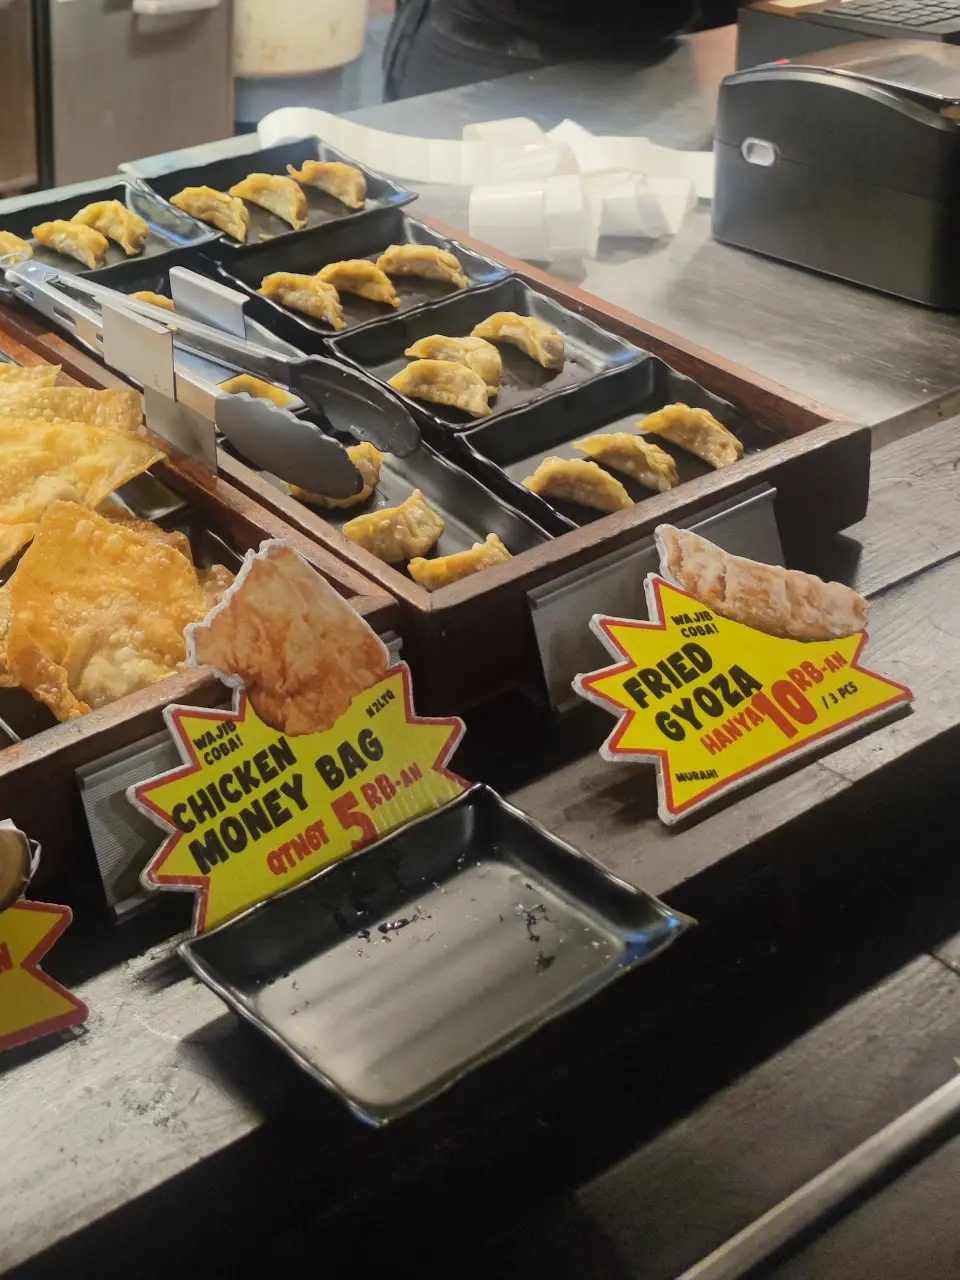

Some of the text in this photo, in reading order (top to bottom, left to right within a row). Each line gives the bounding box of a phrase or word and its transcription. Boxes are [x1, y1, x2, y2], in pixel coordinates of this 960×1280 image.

[671, 611, 713, 625] WAJIB
[681, 623, 719, 638] COBA!
[622, 642, 713, 709] FRIED
[828, 692, 838, 704] 3
[837, 681, 858, 698] PCS
[655, 664, 763, 741] GYOZA
[700, 651, 848, 755] HANYA 10 RB-AN
[193, 720, 237, 751] WAJIB
[204, 734, 243, 765] COBA!
[172, 736, 297, 834] CHICKEN
[675, 769, 718, 782] MURAH!
[188, 728, 384, 875] MONEY BAG
[331, 791, 380, 851] 5
[360, 762, 423, 811] RB-AN
